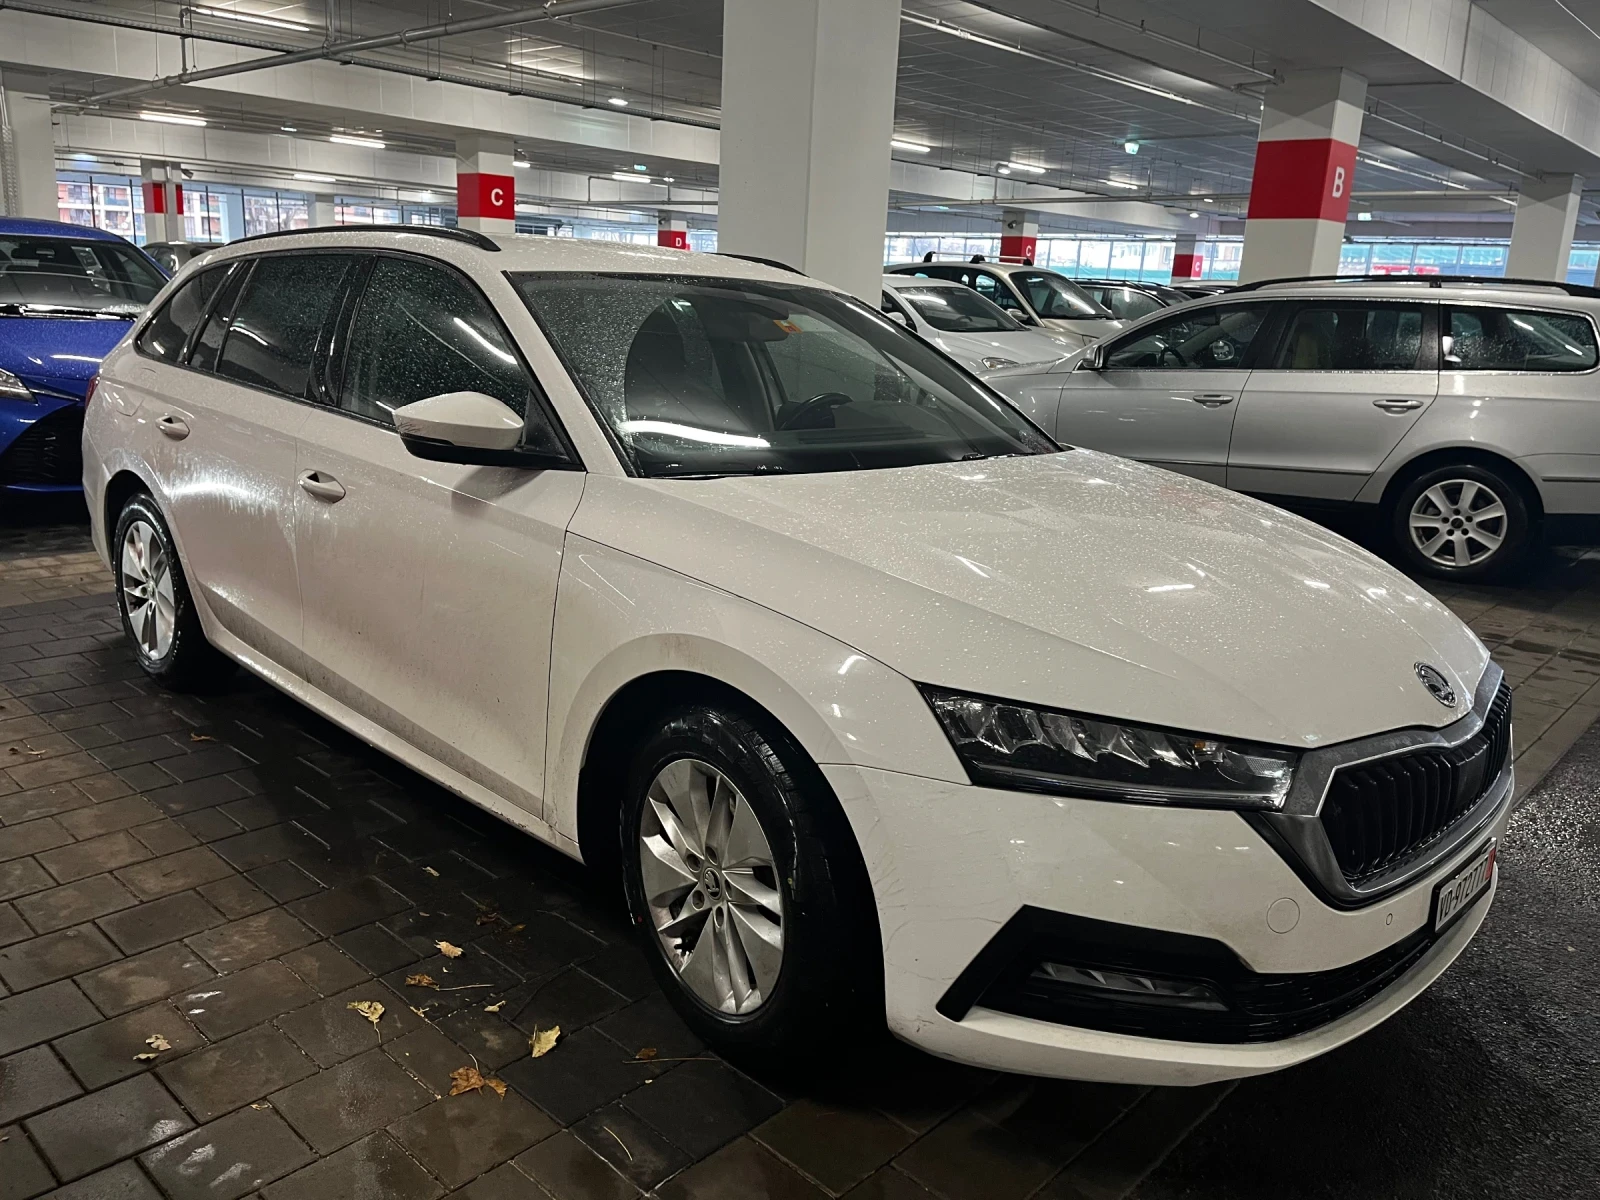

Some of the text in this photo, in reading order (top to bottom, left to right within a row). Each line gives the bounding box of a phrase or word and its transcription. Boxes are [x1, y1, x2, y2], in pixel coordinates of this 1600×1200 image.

[1332, 166, 1345, 198] B
[491, 188, 503, 207] C
[675, 237, 682, 247] D
[1026, 245, 1032, 257] C
